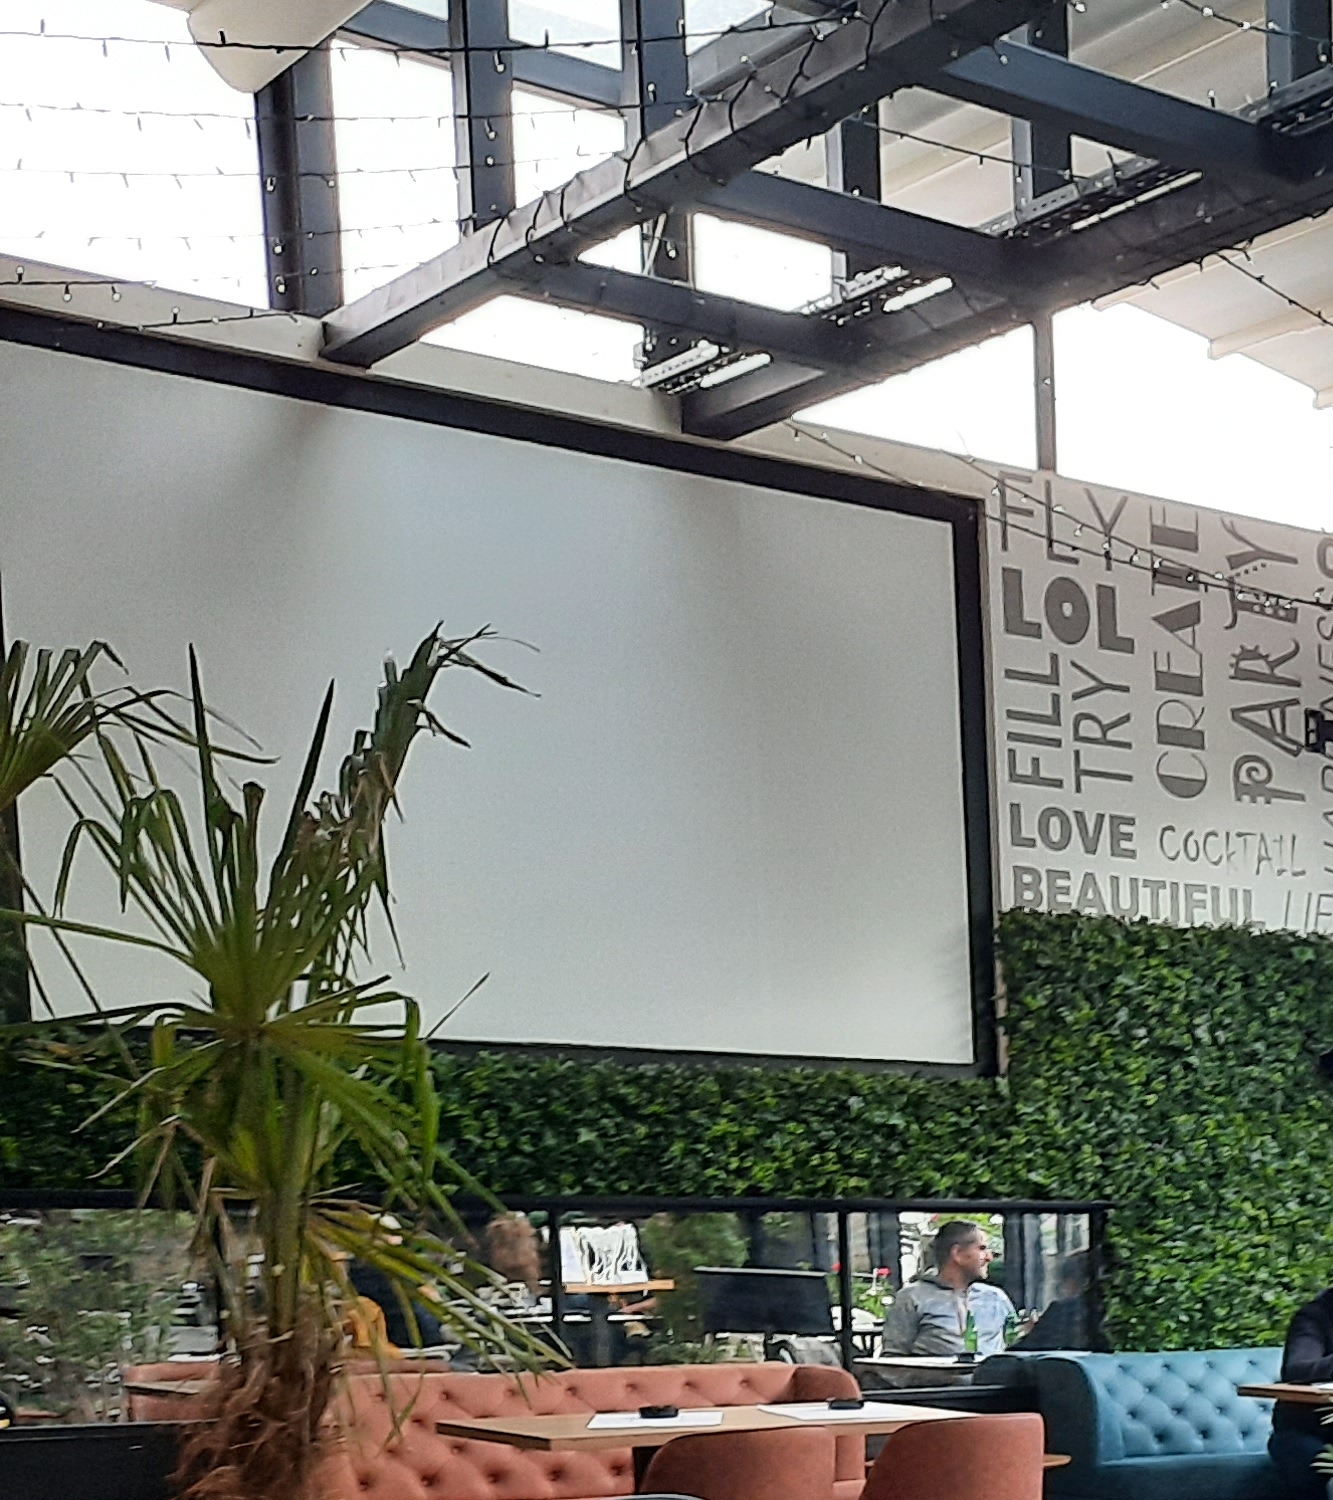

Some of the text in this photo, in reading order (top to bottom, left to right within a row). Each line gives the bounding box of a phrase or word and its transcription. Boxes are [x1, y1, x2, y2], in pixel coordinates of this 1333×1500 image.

[999, 469, 1129, 571] FLY
[1150, 505, 1208, 799] CREATE
[1220, 515, 1306, 805] PARTY
[1004, 652, 1064, 789] FILL
[1069, 659, 1134, 794] TRY
[1009, 802, 1138, 860] LOVE
[1159, 824, 1307, 880] COCKTAIL
[1011, 865, 1267, 932] BEAUTIFUL
